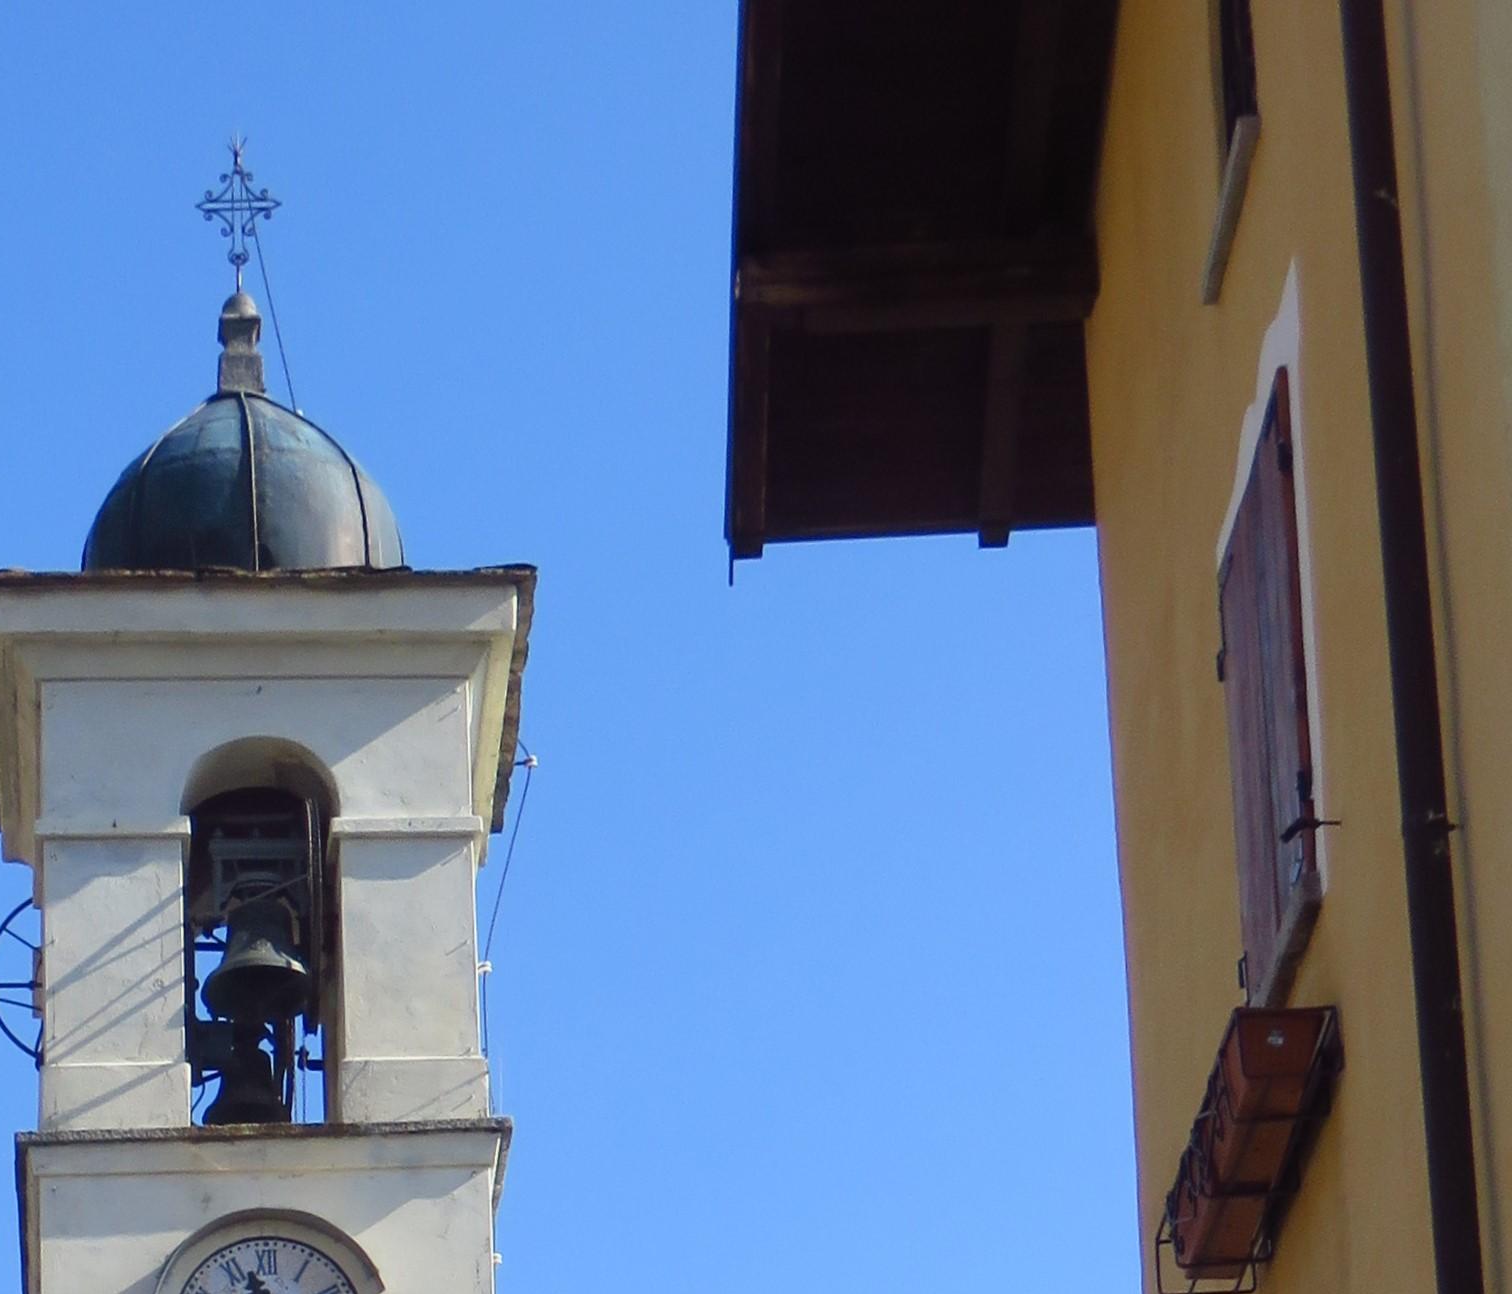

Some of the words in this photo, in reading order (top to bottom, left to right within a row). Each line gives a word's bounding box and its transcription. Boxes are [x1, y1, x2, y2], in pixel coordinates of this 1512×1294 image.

[220, 1257, 246, 1286] XI
[255, 1249, 278, 1276] XII
[294, 1260, 310, 1283] I
